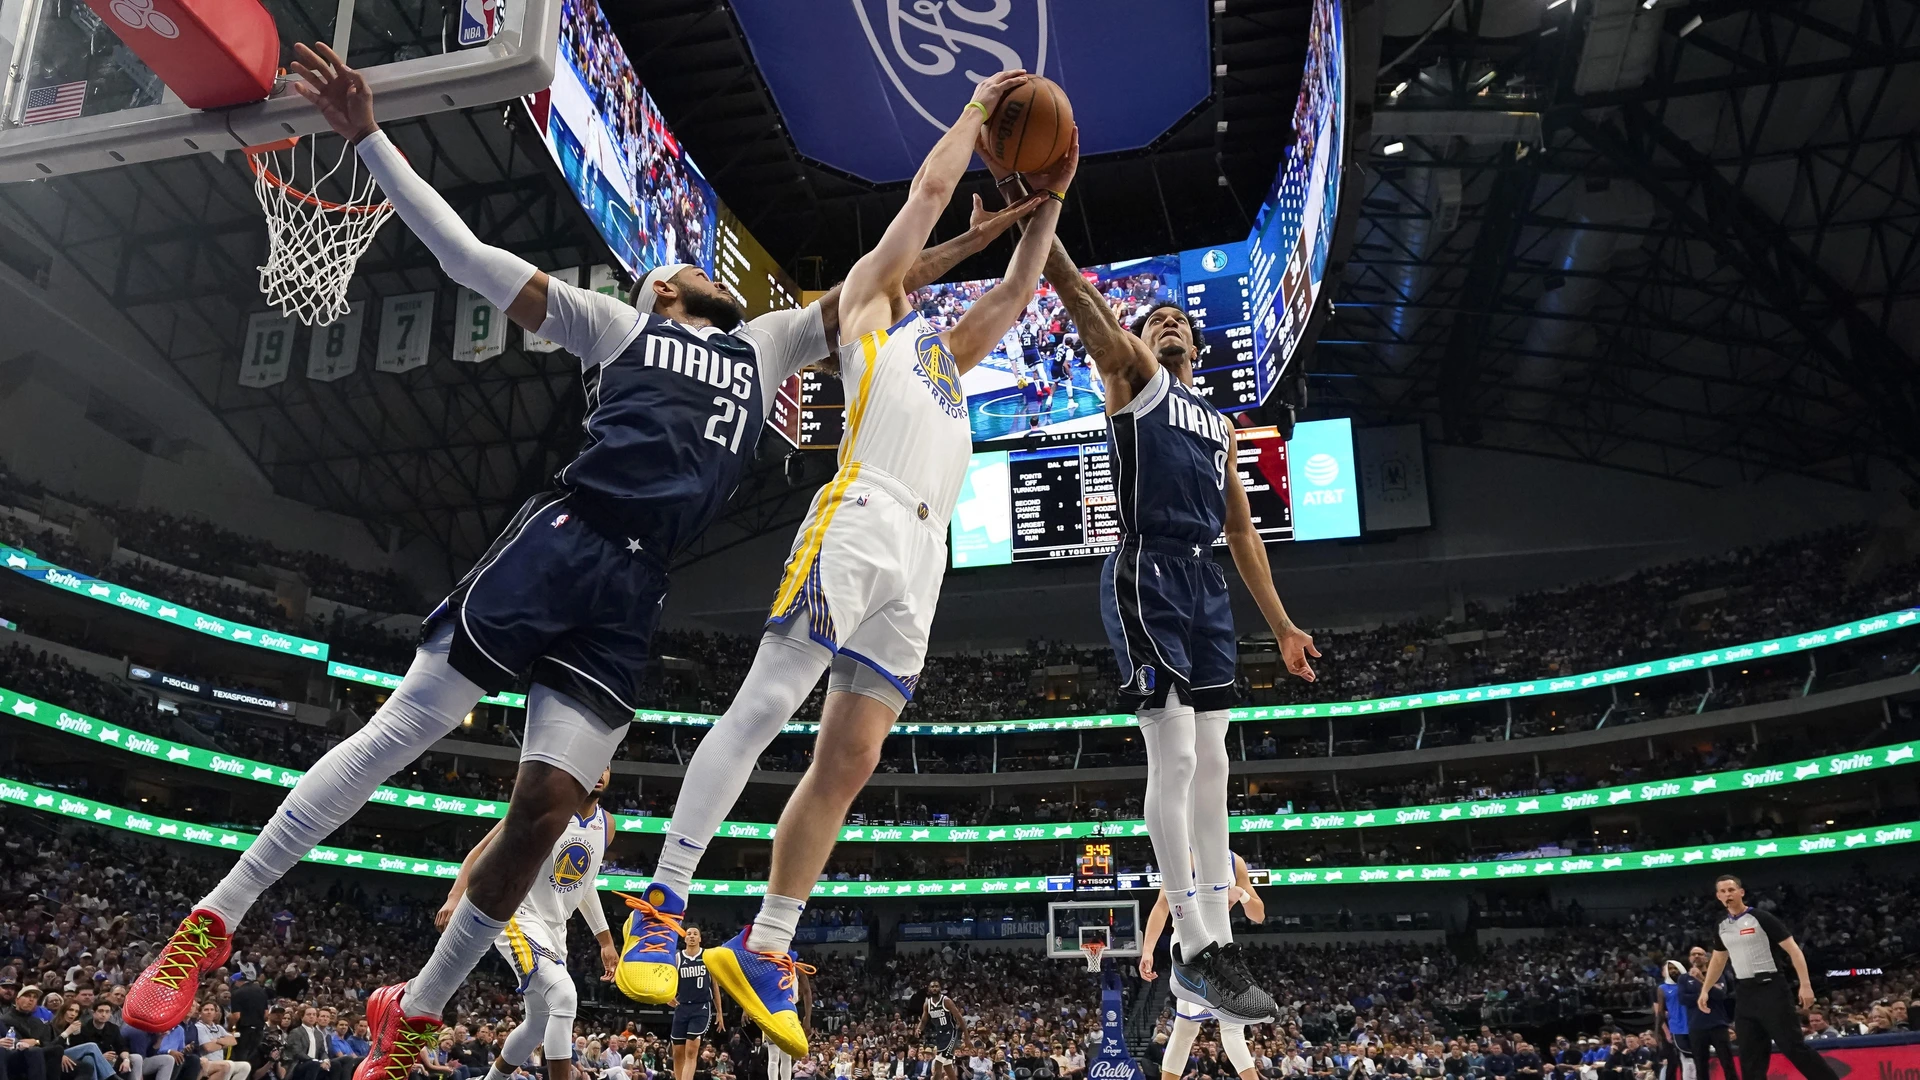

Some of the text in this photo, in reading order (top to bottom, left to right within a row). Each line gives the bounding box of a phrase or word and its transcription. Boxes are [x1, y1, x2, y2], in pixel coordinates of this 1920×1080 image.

[464, 26, 480, 40] NBA
[995, 100, 1024, 160] Wilson
[1187, 276, 1248, 294] REB 11
[1188, 297, 1201, 305] TO
[1243, 301, 1249, 310] 2
[471, 305, 489, 341] 9
[397, 314, 416, 350] 7
[1225, 326, 1252, 338] 15/25
[326, 321, 346, 358] 8
[1023, 338, 1031, 346] 21
[1232, 338, 1252, 349] 6/12
[251, 331, 284, 366] 19
[1237, 351, 1253, 361] 0/2
[644, 334, 752, 400] MAVS
[1232, 369, 1245, 378] 60
[803, 372, 814, 380] FG
[803, 383, 822, 391] 3-PT
[913, 363, 967, 419] WARRIORS
[1233, 382, 1246, 391] 50
[802, 395, 813, 403] FT
[1239, 394, 1247, 402] 0
[802, 411, 813, 419] FG
[1169, 392, 1230, 452] MAVS
[704, 396, 748, 454] 21
[1215, 450, 1228, 490] 9
[1013, 485, 1050, 493] TURNOVERS
[1303, 488, 1345, 506] AT&T
[1017, 521, 1045, 529] LARGEST
[46, 569, 81, 588] Sprite
[117, 592, 149, 610] Sprite
[195, 617, 224, 633] Sprite
[260, 634, 291, 649] Sprite
[334, 666, 357, 677] Sprite
[641, 713, 663, 721] Sprite
[686, 716, 709, 725] Sprite
[932, 725, 953, 734] Sprite
[976, 723, 997, 734] Sprite
[1027, 722, 1049, 731] Sprite
[1072, 720, 1093, 728] Sprite
[1273, 708, 1296, 718] Sprite
[1330, 706, 1352, 715] Sprite
[1378, 701, 1401, 710] Sprite
[1437, 694, 1460, 704] Sprite
[1488, 688, 1511, 698] Sprite
[1550, 680, 1575, 691] Sprite
[1603, 671, 1628, 682] Sprite
[1668, 659, 1694, 671] Sprite
[1726, 649, 1753, 660] Sprite
[1798, 635, 1826, 647] Sprite
[1859, 620, 1888, 634] Sprite
[162, 676, 200, 692] F-150 CLUB
[213, 689, 276, 708] TEXASFORD.COM
[56, 713, 91, 733] Sprite
[126, 735, 158, 753] Sprite
[210, 756, 244, 773] Sprite
[433, 798, 466, 811] Sprite
[728, 825, 759, 837] Sprite
[871, 829, 902, 841] Sprite
[948, 829, 979, 842] Sprite
[1014, 827, 1044, 840] Sprite
[1240, 818, 1273, 831] Sprite
[1311, 815, 1344, 829] Sprite
[1396, 809, 1430, 824] Sprite
[1470, 803, 1506, 818] Sprite
[1562, 794, 1598, 810] Sprite
[1641, 783, 1680, 800] Sprite
[1742, 770, 1783, 787] Sprite
[1830, 755, 1872, 774] Sprite
[59, 799, 88, 814] Sprite
[125, 815, 152, 830] Sprite
[183, 827, 213, 841] Sprite
[308, 848, 338, 861] Sprite
[379, 858, 406, 869] Sprite
[864, 885, 889, 896] Sprite
[917, 884, 943, 894] Sprite
[981, 882, 1007, 893] Sprite
[1288, 872, 1317, 883] Sprite
[1360, 870, 1389, 881] Sprite
[1421, 868, 1451, 880] Sprite
[1496, 864, 1526, 876] Sprite
[1561, 860, 1593, 872] Sprite
[1642, 854, 1674, 867] Sprite
[1711, 847, 1745, 860] Sprite
[1799, 838, 1835, 852] Sprite
[1875, 828, 1912, 843] Sprite
[560, 837, 595, 855] GOLDEN STATE
[1086, 844, 1110, 856] 9:45
[577, 856, 585, 867] 4
[1082, 856, 1108, 874] 24
[1001, 922, 1045, 937] BREAKERS
[680, 965, 706, 978] MAVS
[697, 977, 703, 988] 0
[939, 1016, 947, 1026] 10
[1103, 1046, 1122, 1056] Kroger
[1091, 1061, 1135, 1080] Bally
